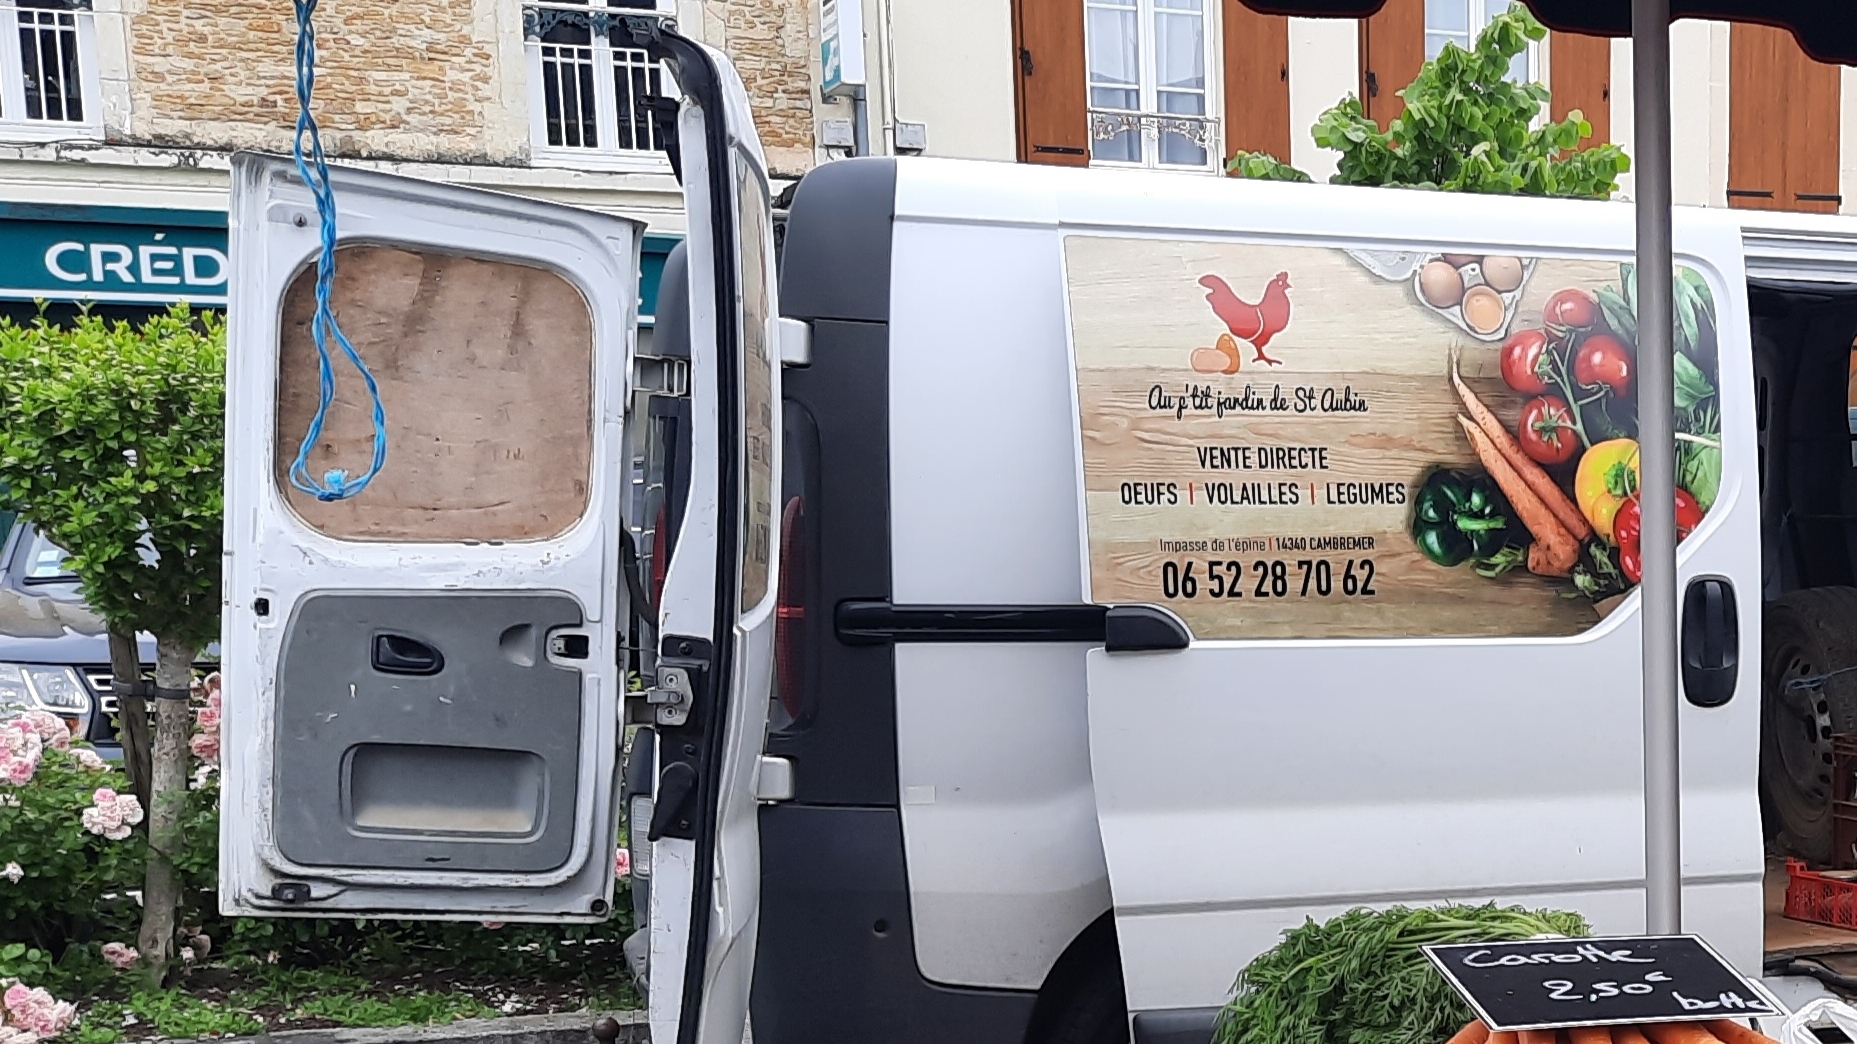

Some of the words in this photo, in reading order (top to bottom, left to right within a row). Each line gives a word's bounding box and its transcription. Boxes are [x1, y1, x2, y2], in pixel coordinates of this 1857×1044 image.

[1148, 384, 1175, 411] Au
[1177, 384, 1213, 420] p'tit
[1216, 383, 1266, 418] jardin
[1270, 385, 1288, 412] de
[1294, 386, 1316, 413] St
[1321, 387, 1368, 412] Aubin
[1197, 447, 1252, 469] VENTE
[1257, 447, 1329, 469] DIRECTE
[1121, 483, 1178, 505] OEUFS
[1205, 483, 1299, 505] VOLAILLES
[1326, 483, 1406, 504] LEGUMES
[1160, 538, 1207, 553] Impasse
[1211, 538, 1225, 551] de
[1228, 537, 1265, 553] l'épine
[1275, 537, 1306, 550] 14340
[1309, 537, 1374, 550] CAMBREMER
[1162, 561, 1197, 598] 06
[1208, 561, 1242, 598] 52
[1253, 560, 1287, 597] 28
[1298, 559, 1332, 597] 70
[1342, 559, 1376, 596] 62
